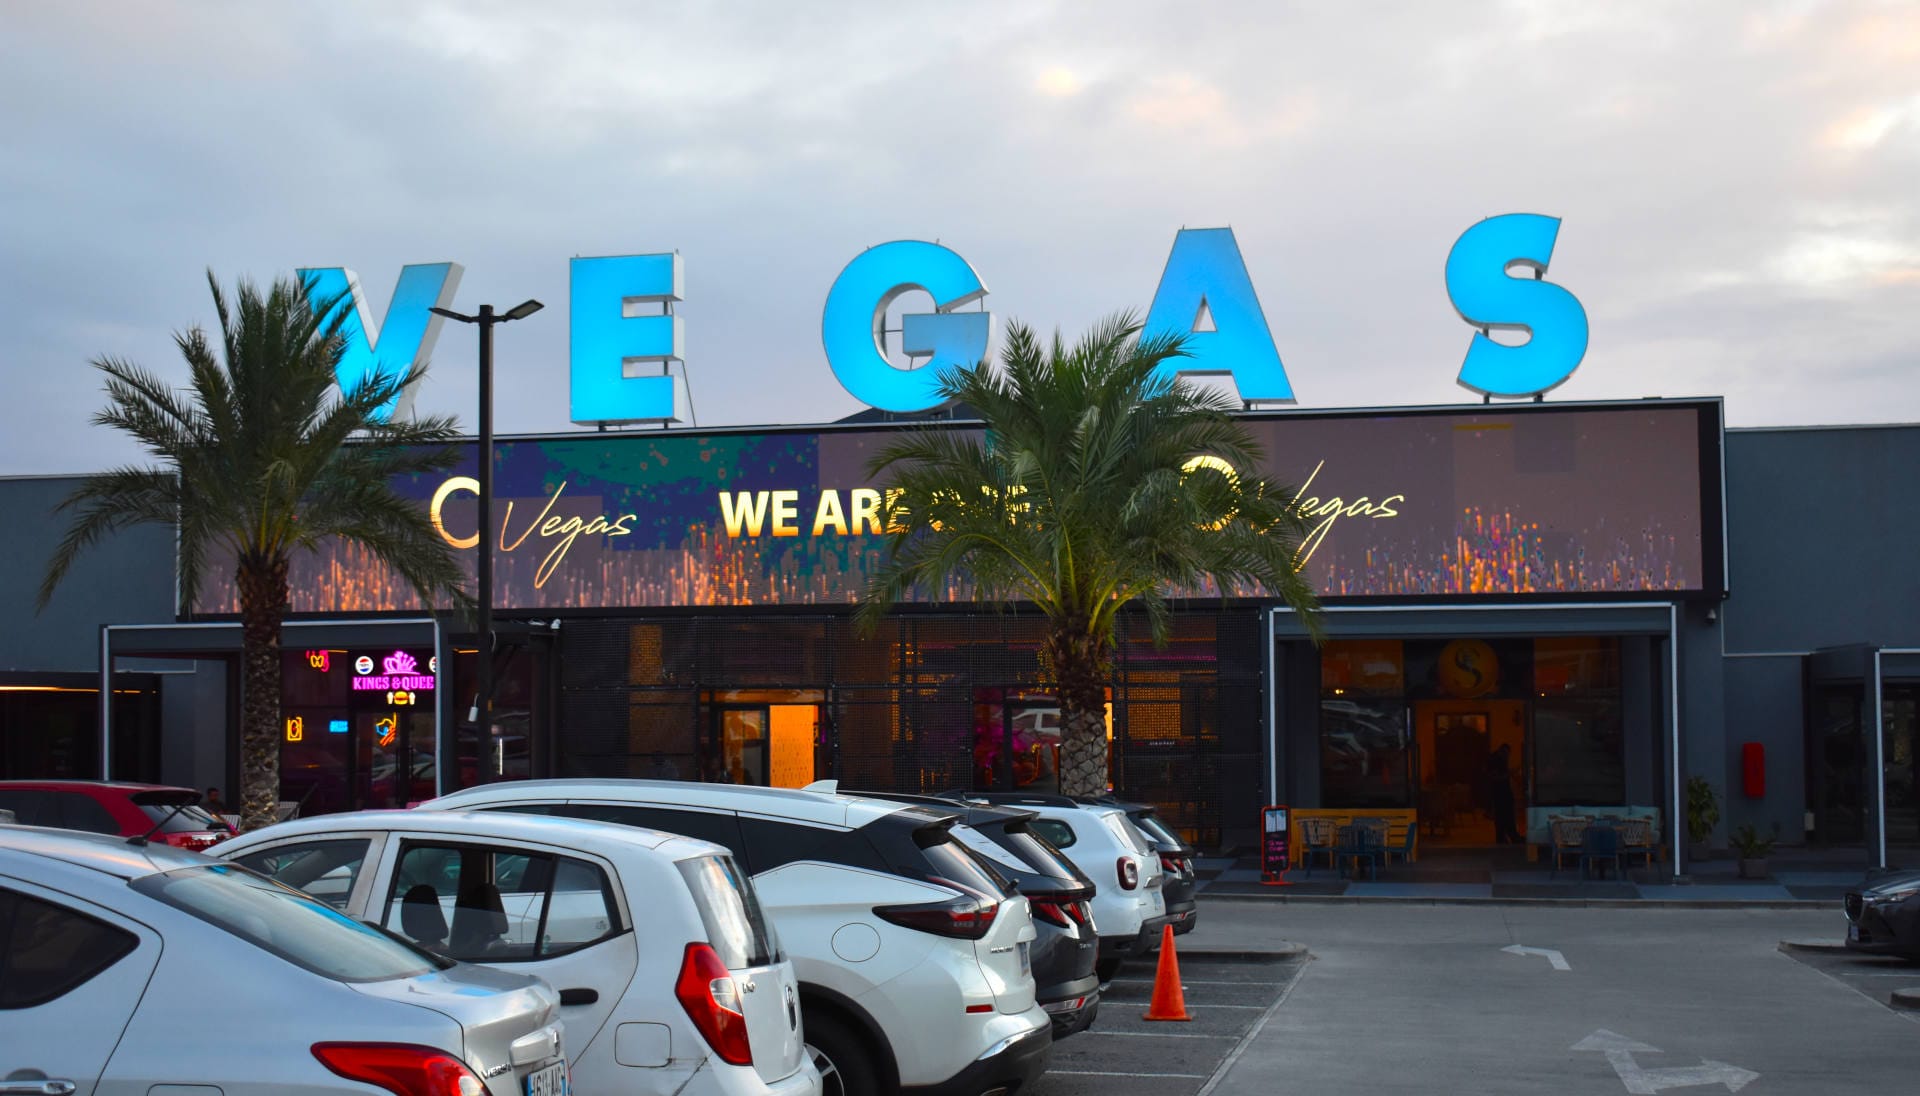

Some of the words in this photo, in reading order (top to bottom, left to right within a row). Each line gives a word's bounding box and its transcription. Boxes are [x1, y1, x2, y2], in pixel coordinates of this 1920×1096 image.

[296, 213, 1589, 425] VEGAS
[500, 481, 637, 589] Vegas
[719, 490, 799, 537] WE
[353, 676, 390, 690] KINGS
